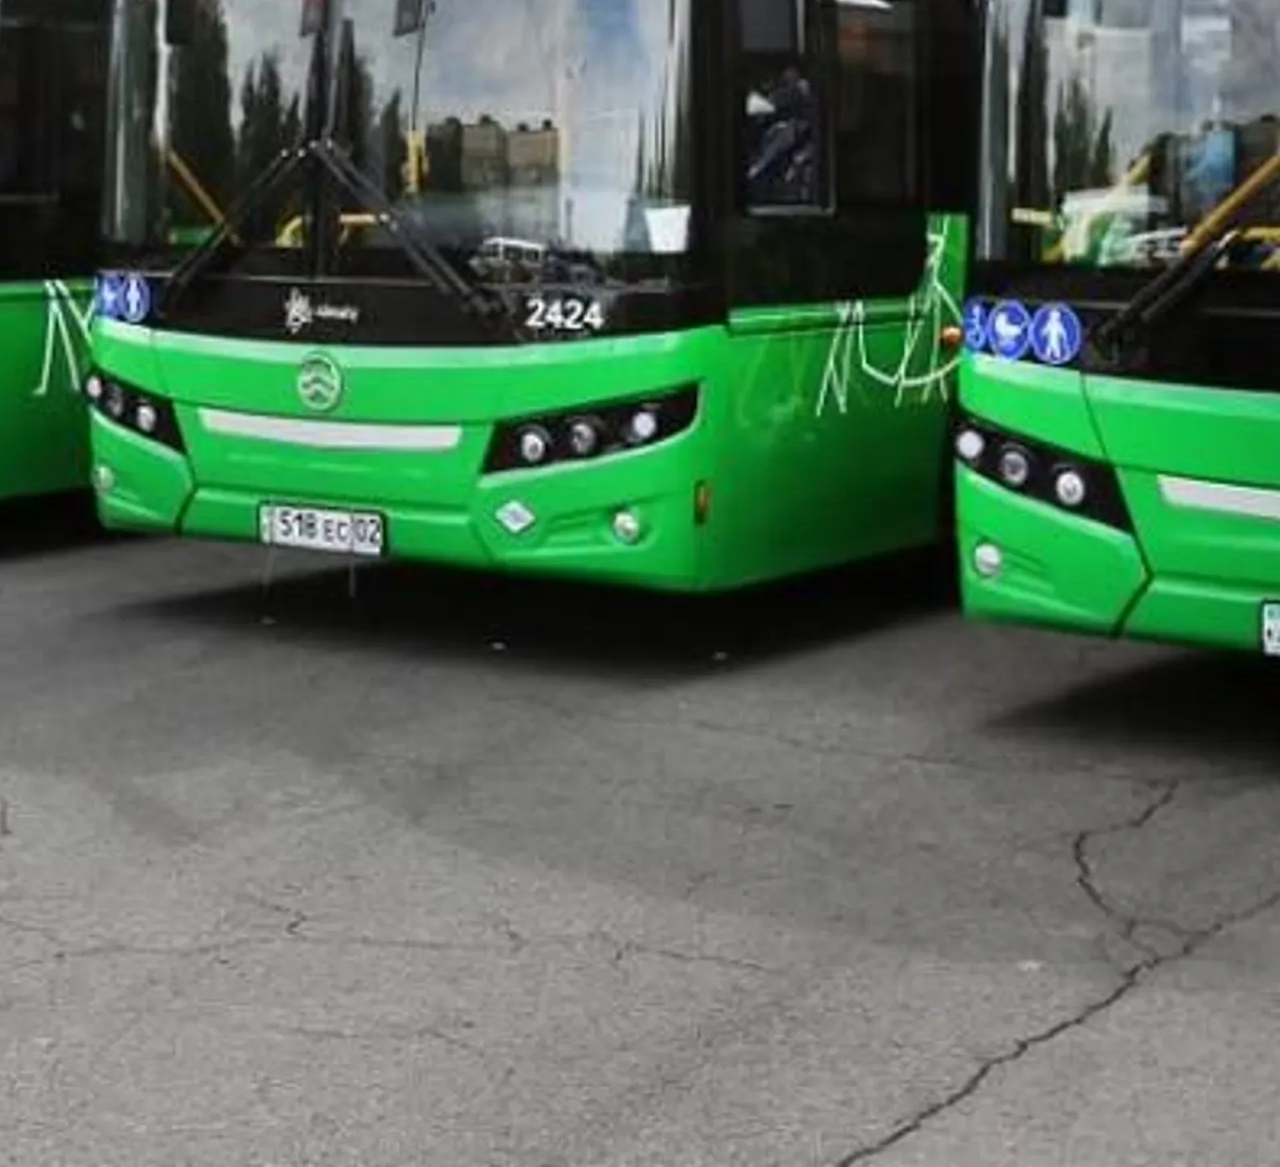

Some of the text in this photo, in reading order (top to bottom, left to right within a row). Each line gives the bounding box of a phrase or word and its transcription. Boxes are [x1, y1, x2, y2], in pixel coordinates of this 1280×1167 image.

[524, 297, 605, 330] 2424
[278, 509, 319, 540] 518
[352, 518, 382, 546] 02
